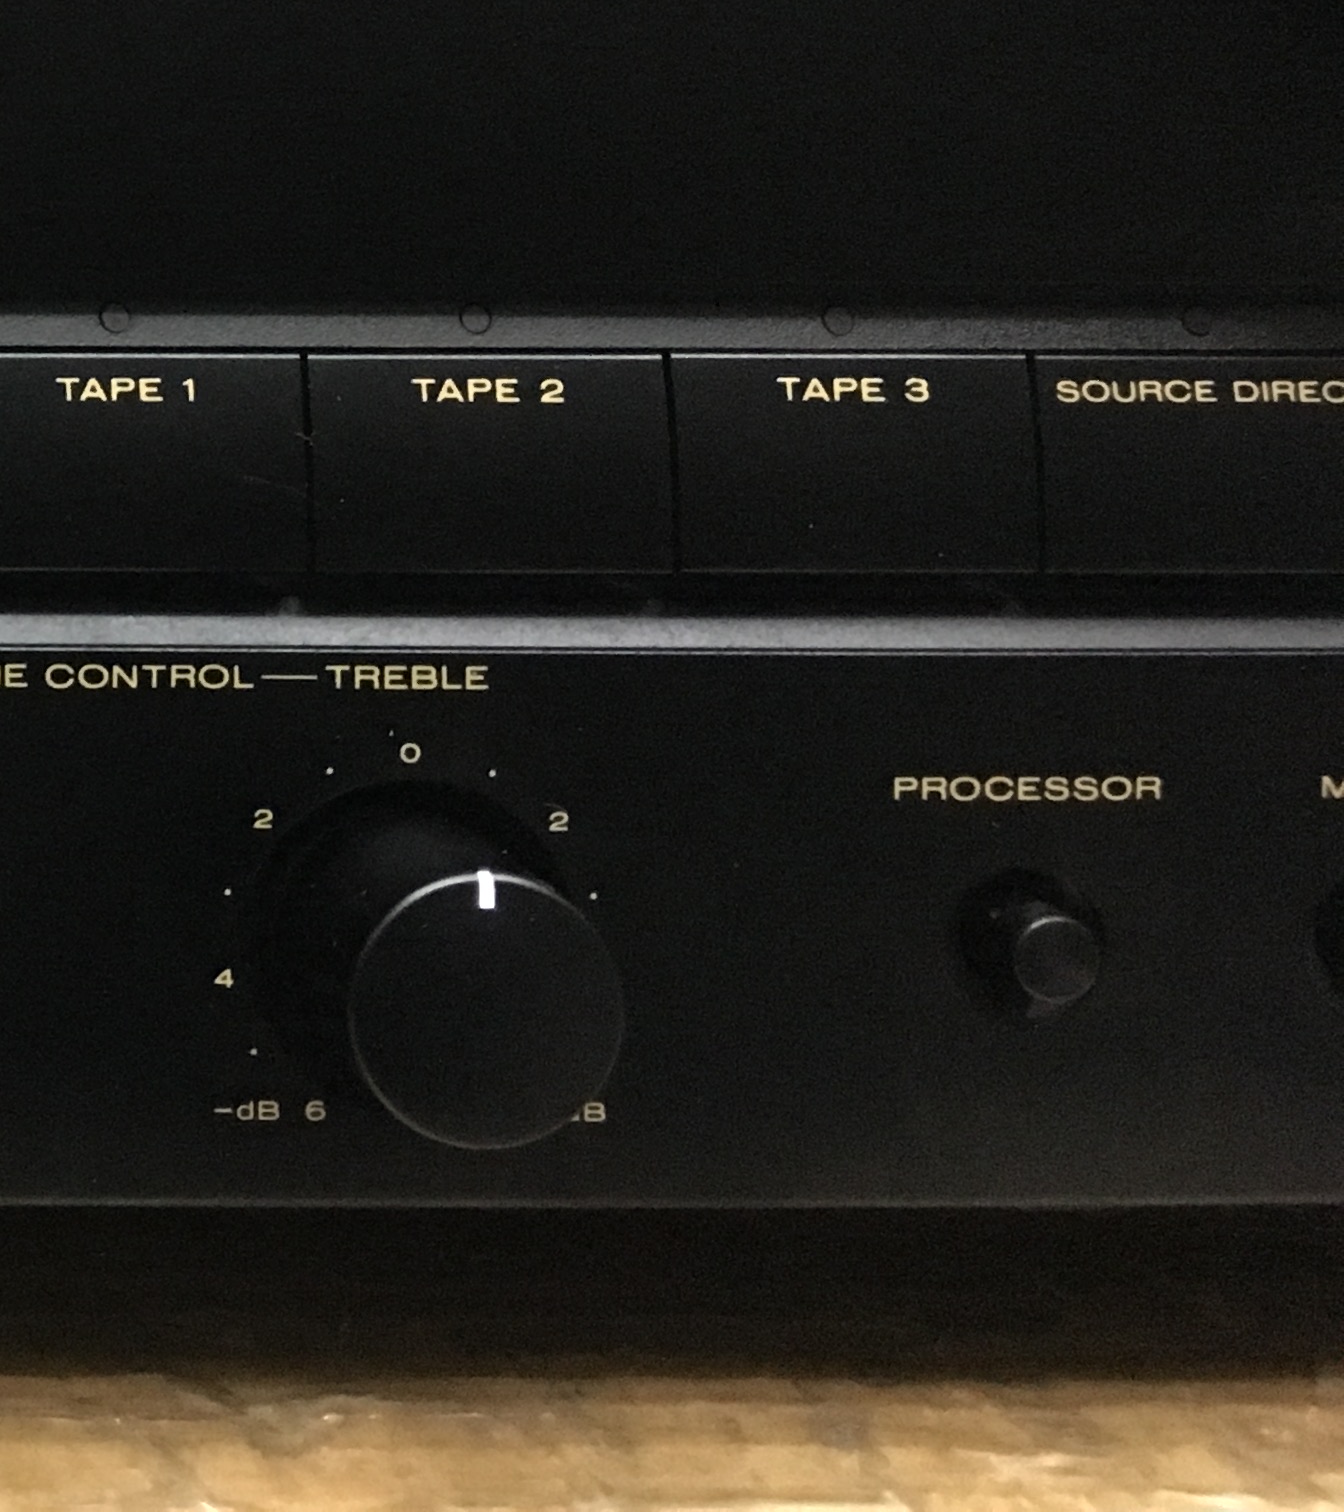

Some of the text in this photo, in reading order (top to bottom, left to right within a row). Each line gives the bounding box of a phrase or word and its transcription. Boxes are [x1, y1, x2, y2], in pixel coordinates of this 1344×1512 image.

[54, 376, 196, 403] TAPE 1
[409, 376, 566, 405] TAPE 2
[775, 375, 931, 404] TAPE 3
[1055, 378, 1344, 405] SOURCE DIREC
[43, 662, 256, 691] CONTROL
[892, 774, 1163, 803] PROCESSOR
[252, 807, 275, 830] 2
[547, 809, 570, 833] 2
[213, 967, 235, 990] 4
[303, 1099, 328, 1123] 6
